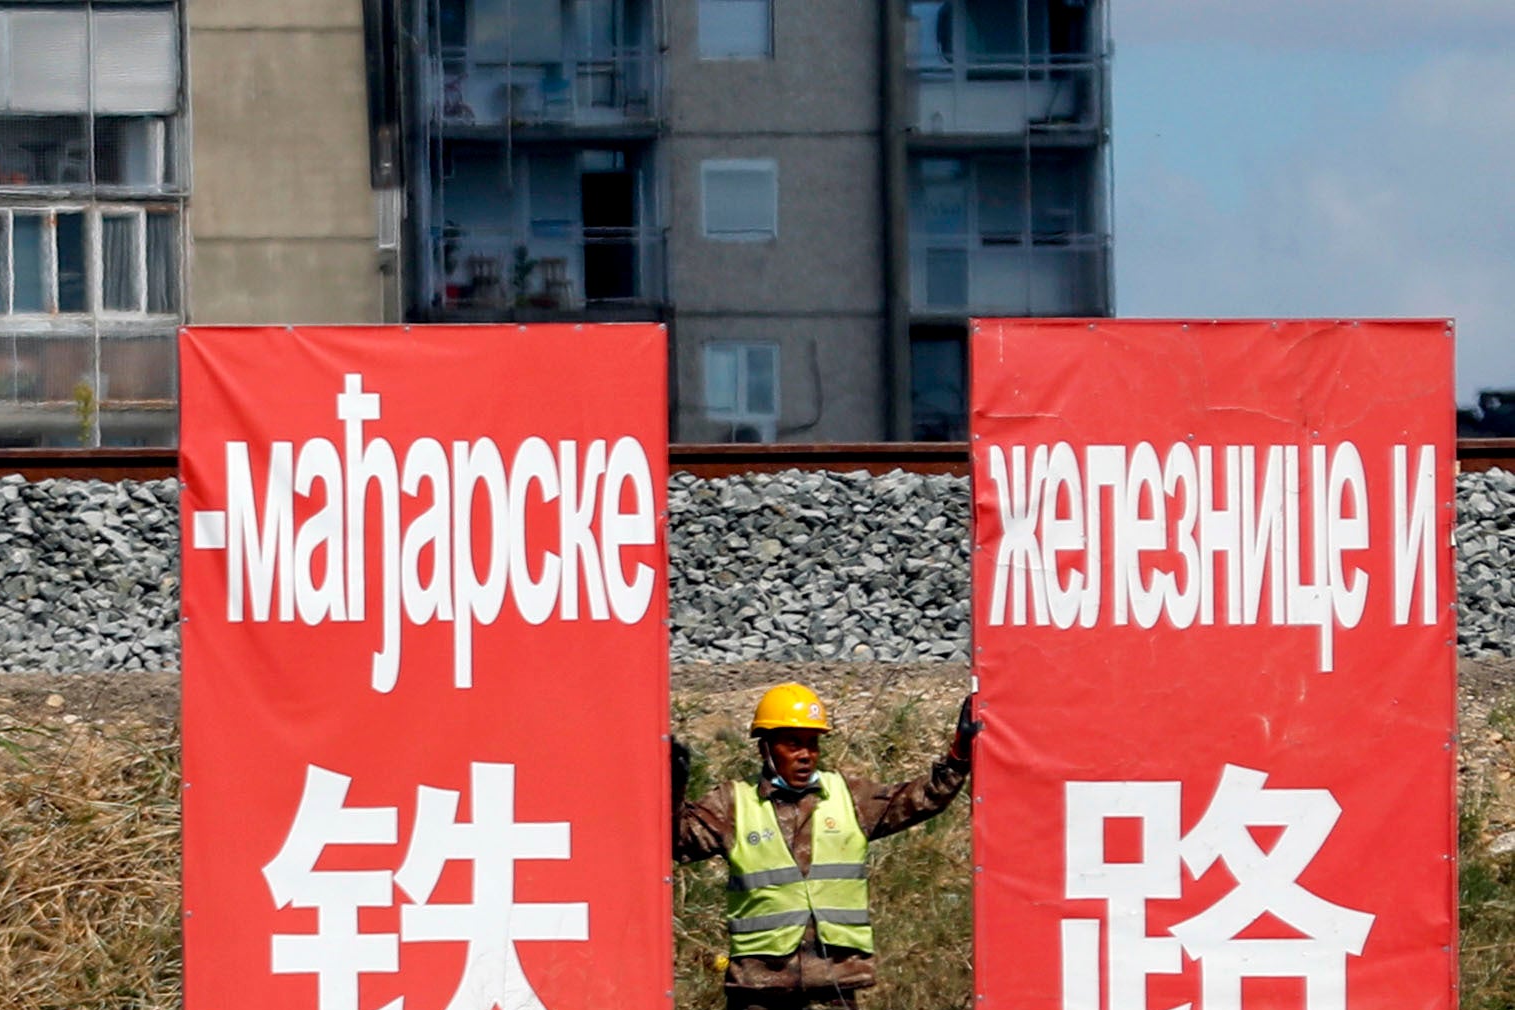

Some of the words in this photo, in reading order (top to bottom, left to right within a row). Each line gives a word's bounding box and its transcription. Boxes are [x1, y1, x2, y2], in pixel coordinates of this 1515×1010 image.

[191, 373, 656, 694] -мађарске
[986, 440, 1371, 673] железнице
[1392, 443, 1437, 626] и
